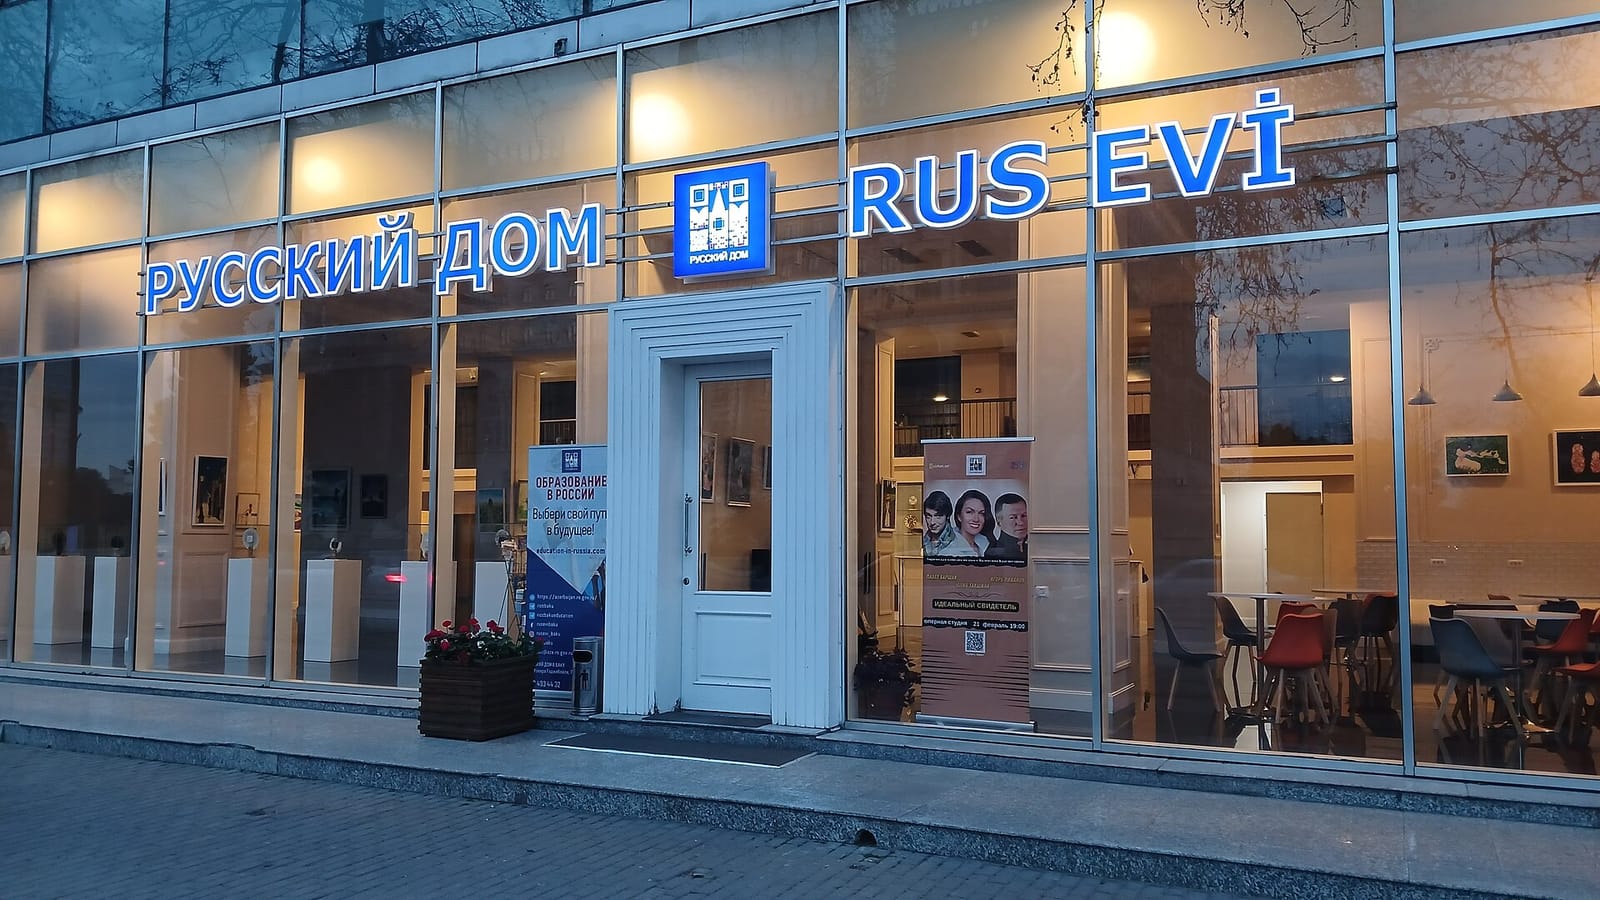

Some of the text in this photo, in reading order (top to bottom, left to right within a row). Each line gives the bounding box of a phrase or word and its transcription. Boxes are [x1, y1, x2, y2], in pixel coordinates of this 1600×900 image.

[849, 87, 1295, 237] RUS EVİ
[145, 202, 604, 316] РУССКИЙ ДОМ
[690, 251, 748, 264] РУССКИЙ ДОМ
[536, 475, 607, 488] ОБРАЗОВАНИЕ
[547, 488, 595, 500] В РОССИИ
[533, 507, 566, 522] Выбери
[567, 507, 589, 519] свой
[547, 524, 595, 539] в будущее!
[536, 547, 605, 555] education-in-russia.com
[934, 600, 1017, 611] ИДЕАЛЬНЫЙ СВИДЕТЕЛЬ
[1010, 622, 1026, 630] 19:00
